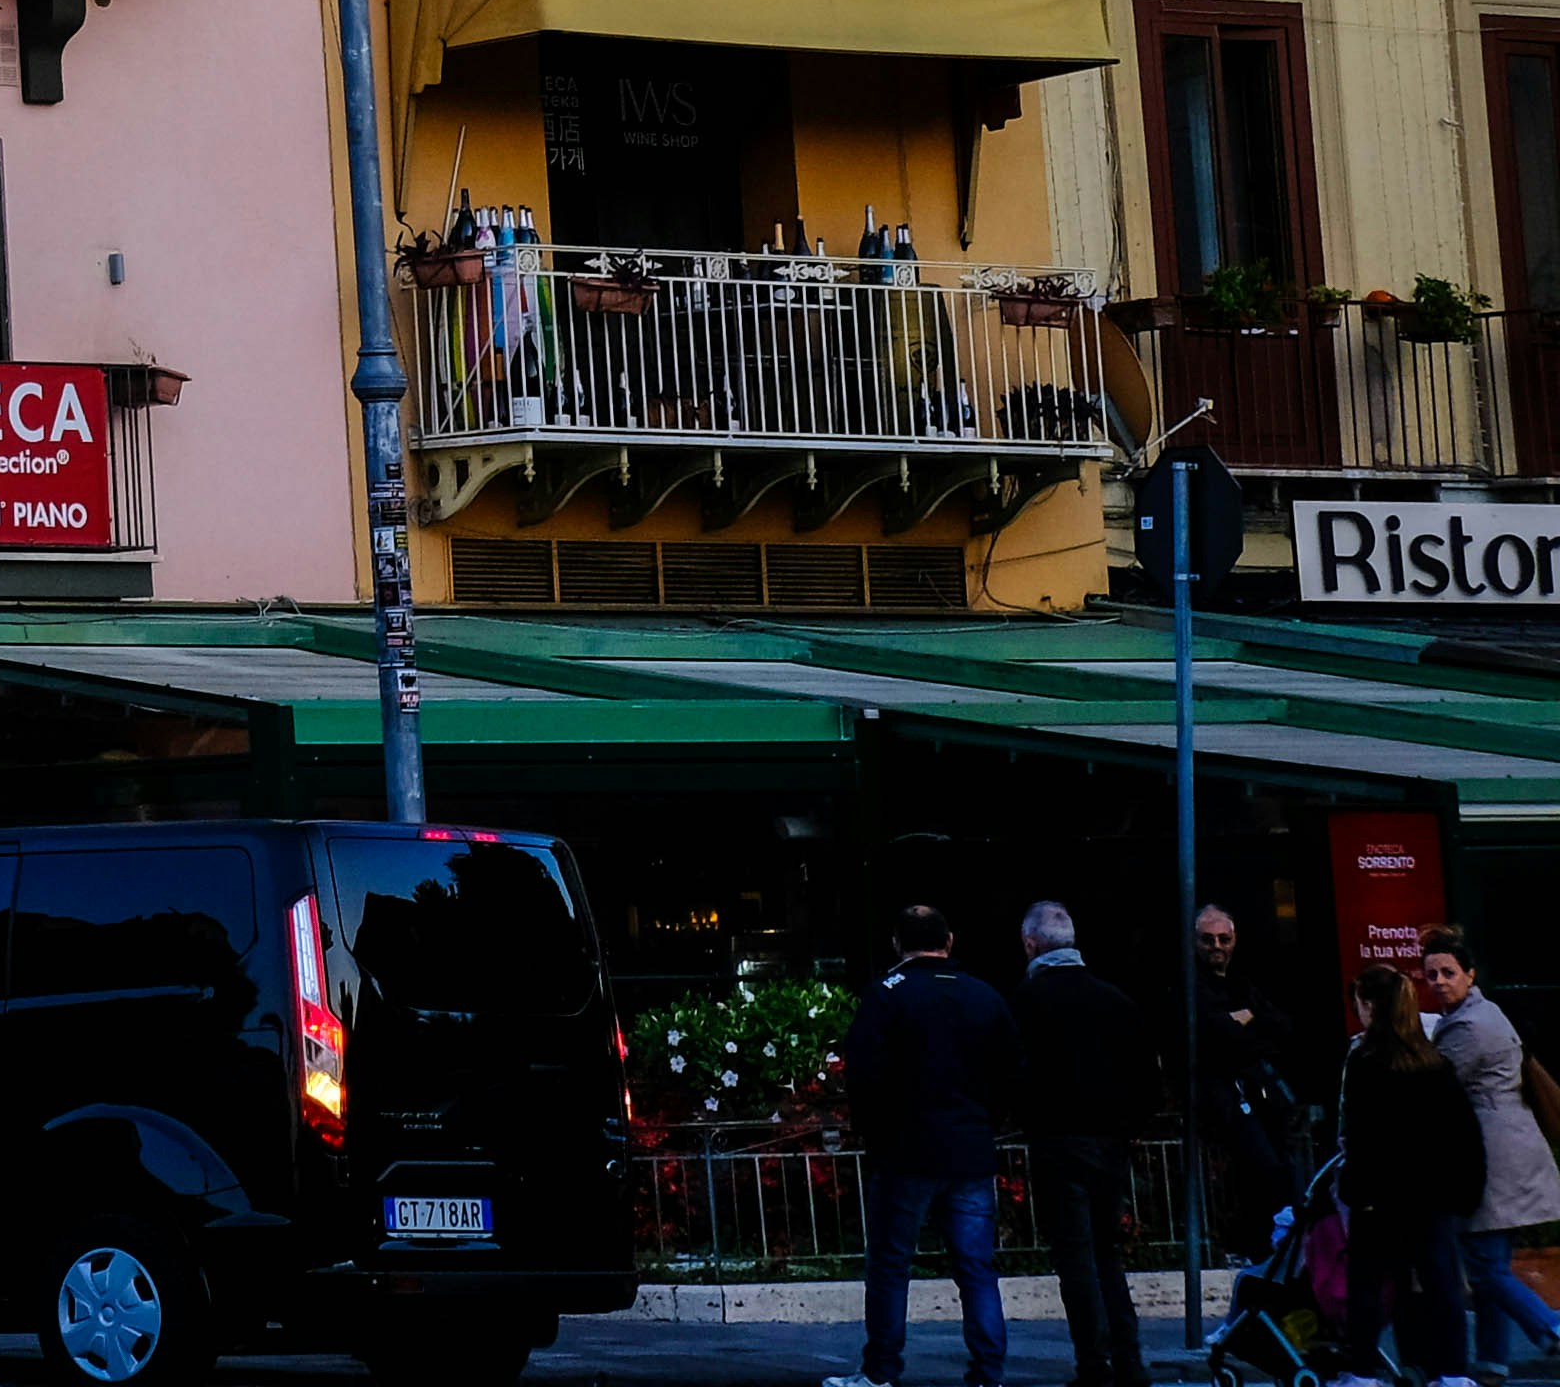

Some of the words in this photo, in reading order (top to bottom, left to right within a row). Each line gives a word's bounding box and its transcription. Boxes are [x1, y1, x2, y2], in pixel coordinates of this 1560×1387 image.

[619, 77, 697, 127] IWS
[623, 131, 658, 146] WINE
[662, 133, 700, 148] SHOP
[13, 502, 88, 529] PIANO
[1357, 855, 1416, 870] SORRENTO
[1367, 924, 1418, 940] Prenota
[1359, 943, 1371, 959] la
[1373, 943, 1395, 959] tua
[398, 1201, 419, 1228] GT
[425, 1201, 481, 1228] 718AR
